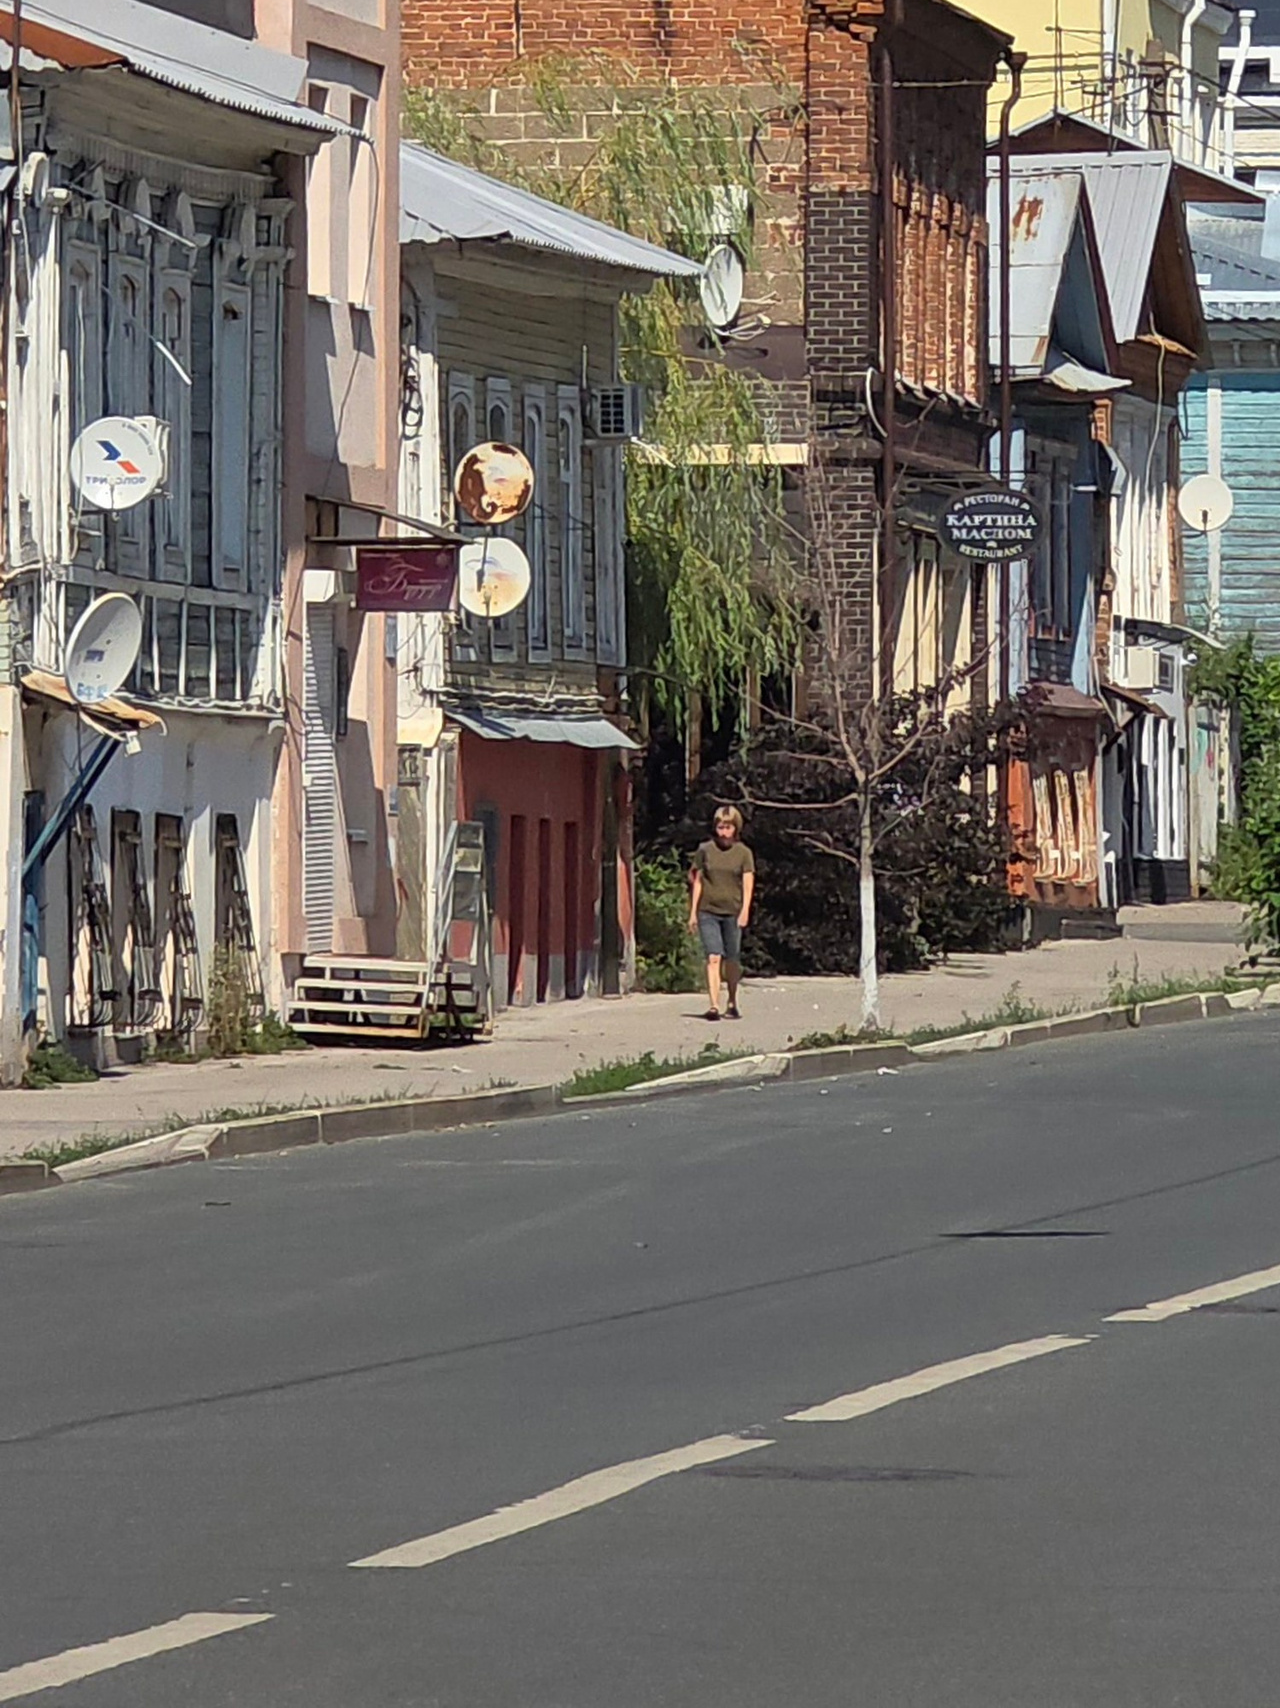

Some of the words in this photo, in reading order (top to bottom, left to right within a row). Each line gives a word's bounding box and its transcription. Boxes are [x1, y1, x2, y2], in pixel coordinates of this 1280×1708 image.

[86, 476, 146, 484] ТРИОЛОР
[964, 494, 1019, 506] РЕСТОРАН
[946, 514, 1037, 526] КАРТИНА
[951, 528, 1033, 540] МАСЛОМ
[959, 544, 1023, 558] RESTAURANT
